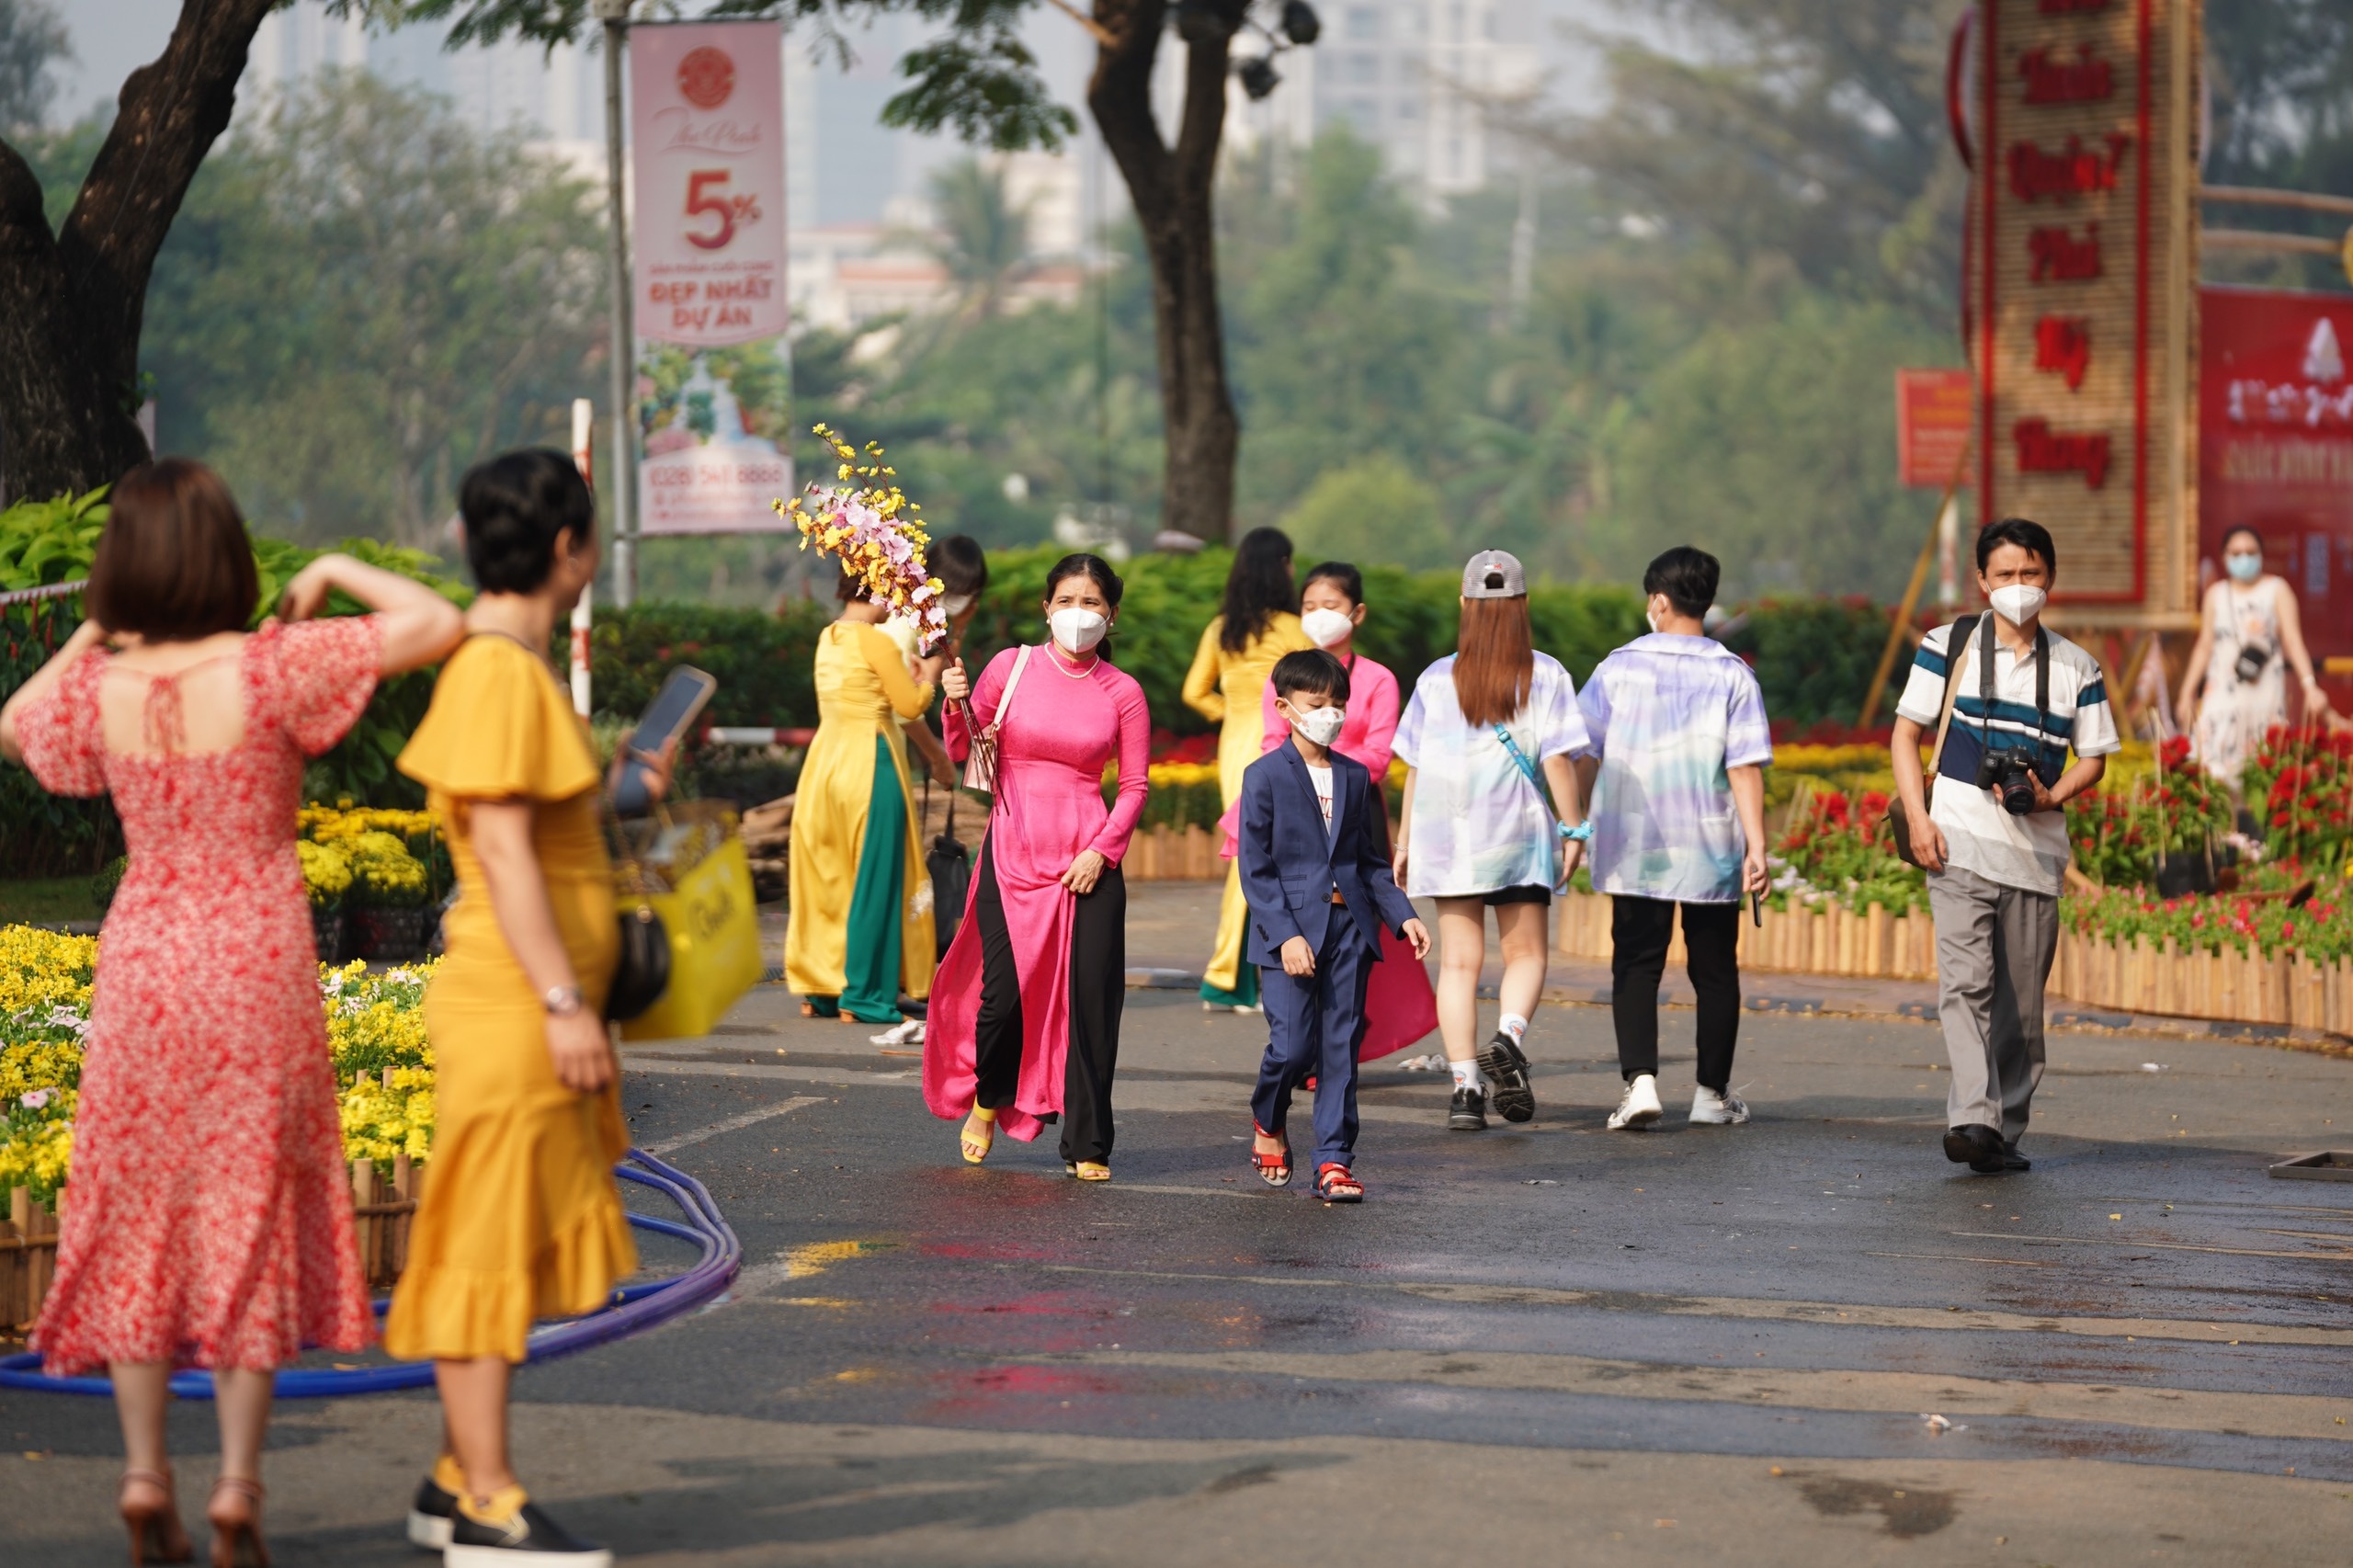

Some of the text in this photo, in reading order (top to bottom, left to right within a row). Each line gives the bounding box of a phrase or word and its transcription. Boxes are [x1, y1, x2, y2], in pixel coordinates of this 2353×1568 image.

[686, 168, 763, 250] 5%
[649, 274, 773, 306] ĐẸP NHẤT
[673, 301, 753, 331] DỰ ÁN
